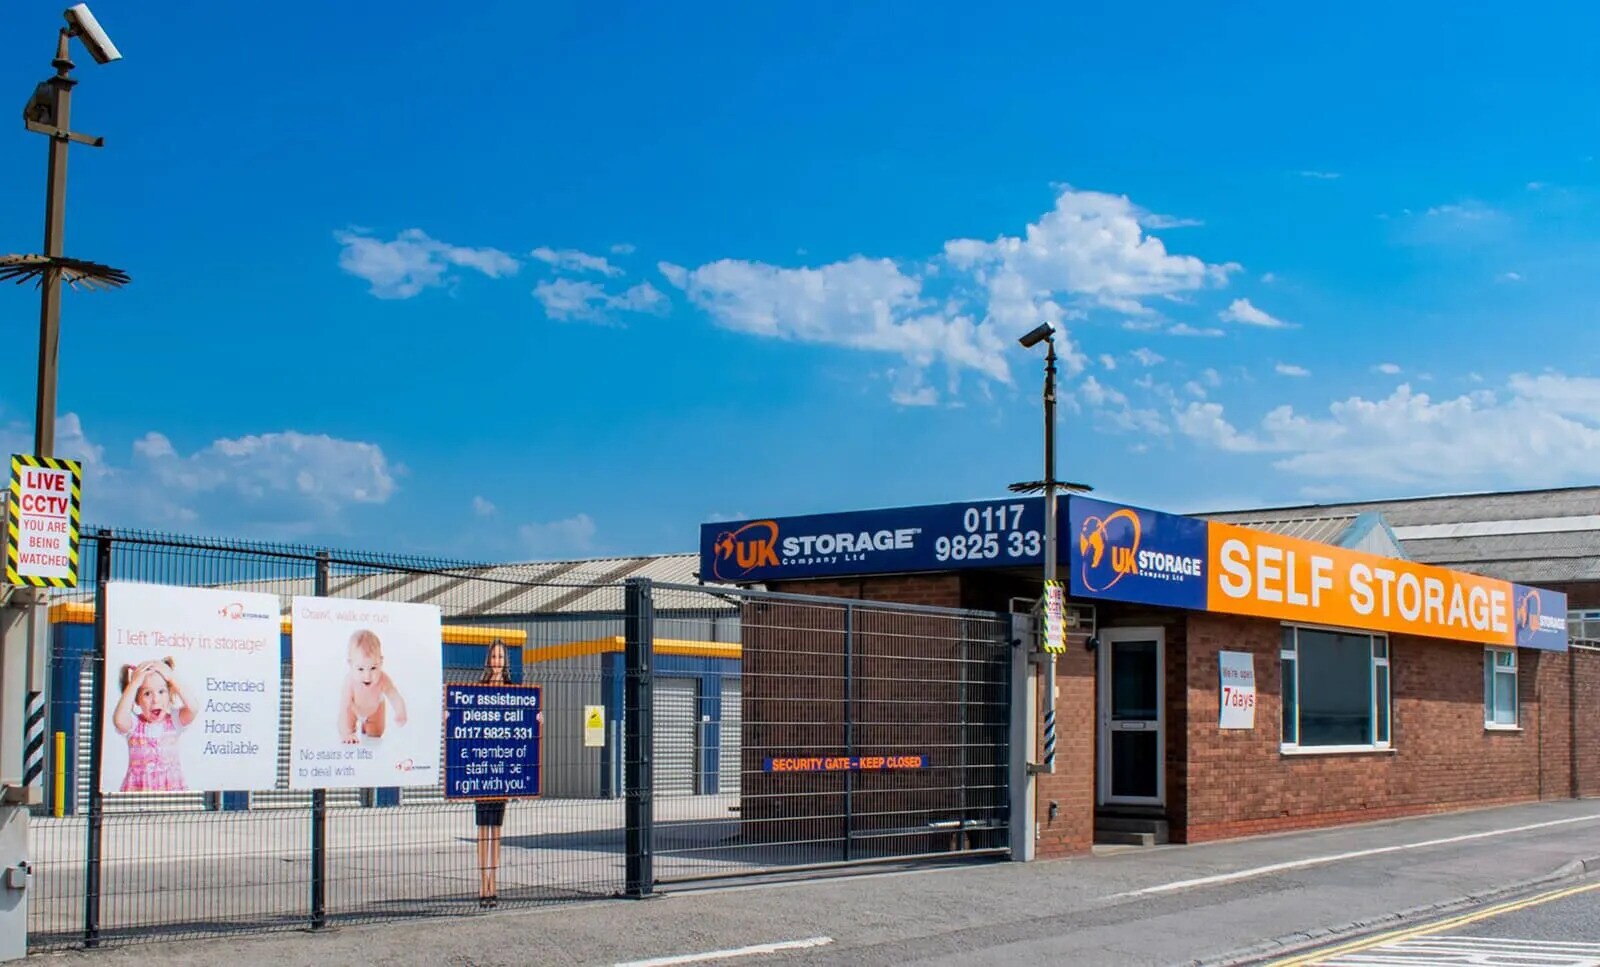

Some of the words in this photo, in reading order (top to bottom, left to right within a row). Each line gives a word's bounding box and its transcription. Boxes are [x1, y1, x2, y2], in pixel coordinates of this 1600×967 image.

[27, 471, 65, 491] LIVE
[22, 494, 69, 514] CCTV
[964, 504, 1024, 533] 0117
[23, 519, 44, 532] YOU
[47, 521, 67, 533] ARE
[29, 536, 60, 549] BEING
[936, 533, 999, 561] 9825
[1007, 530, 1046, 557] 33
[20, 554, 69, 567] WATCHED
[736, 540, 780, 568] UK
[783, 556, 837, 566] Company
[845, 554, 866, 562] Ltd
[1112, 546, 1139, 575] UK
[1139, 550, 1202, 577] STORAGE
[1219, 539, 1333, 607] SELF
[1350, 563, 1508, 633] STORAGE
[127, 630, 148, 646] left
[198, 634, 212, 649] in
[206, 677, 265, 692] Extended
[205, 698, 252, 713] Access
[477, 692, 536, 706] assistance
[1224, 687, 1231, 706] 7
[1232, 689, 1254, 711] days
[463, 710, 502, 724] please
[504, 710, 524, 722] call
[204, 719, 243, 734] Hours
[454, 727, 481, 738] 0117
[483, 727, 511, 739] 9825
[513, 728, 532, 739] 331
[203, 741, 259, 755] Available
[300, 748, 315, 760] No
[316, 750, 342, 760] stairs
[344, 751, 355, 760] or
[357, 747, 374, 760] lifts
[461, 747, 469, 758] a
[516, 744, 527, 758] of
[299, 766, 309, 776] to
[311, 765, 332, 776] deal
[335, 764, 355, 776] with
[466, 761, 489, 775] staff
[772, 758, 824, 771] SECURITY
[825, 757, 850, 770] GATE
[859, 756, 885, 769] KEEP
[886, 756, 922, 768] CLOSED
[481, 776, 503, 790] with
